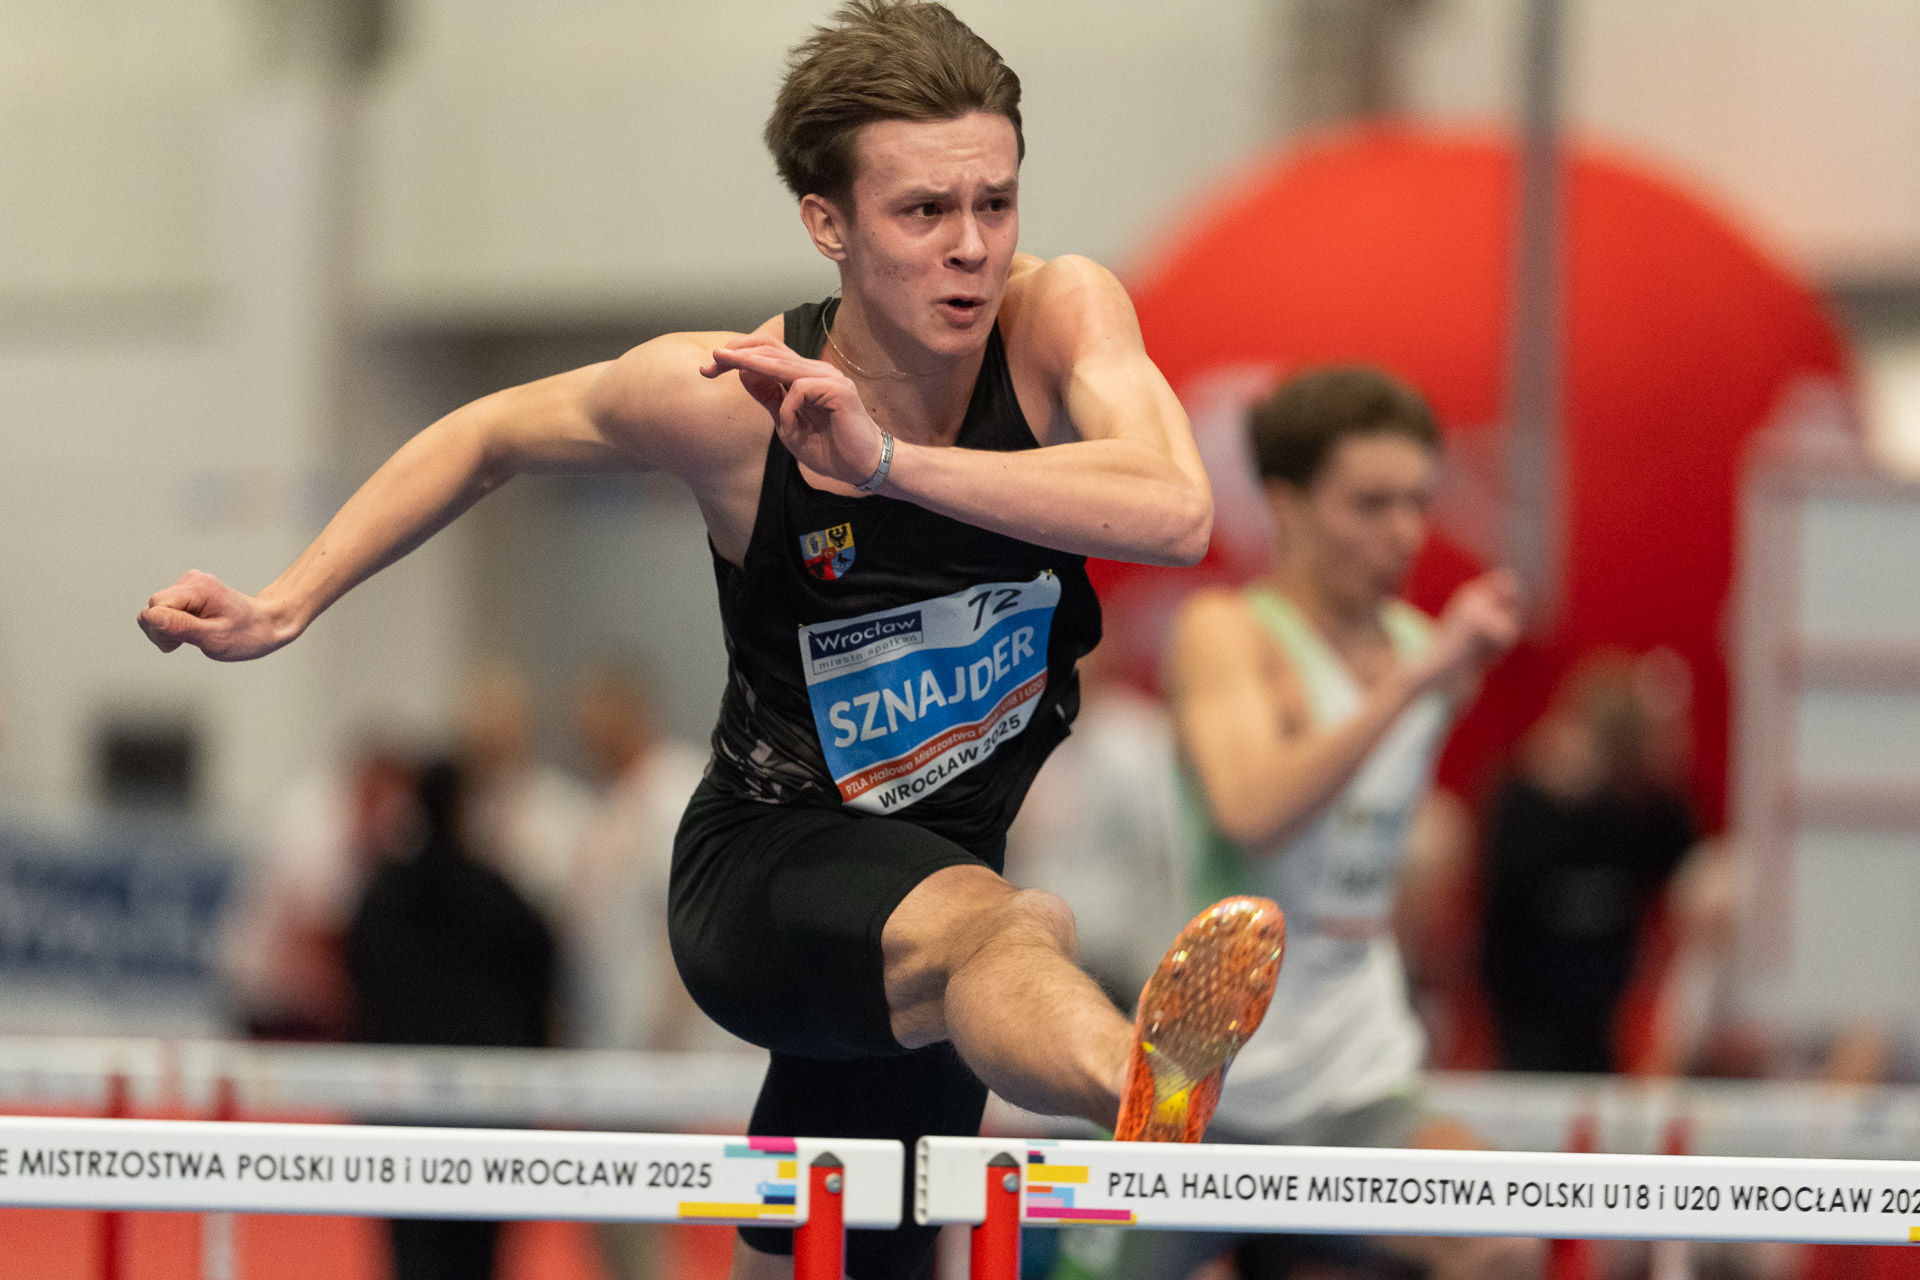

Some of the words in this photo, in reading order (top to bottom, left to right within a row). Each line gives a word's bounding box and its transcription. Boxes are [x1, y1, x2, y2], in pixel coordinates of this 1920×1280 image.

[815, 618, 916, 652] Wrocław
[819, 653, 863, 670] miasto
[829, 625, 1035, 748] SZNAJDER
[845, 777, 869, 795] PZLA
[868, 761, 914, 784] Halowe
[914, 729, 977, 766] Mistrzostwa
[878, 746, 979, 809] WROCŁAW
[982, 714, 1021, 754] 2025
[19, 1149, 225, 1178] MISTRZOSTWA
[238, 1154, 334, 1181] POLSKI
[345, 1157, 395, 1183] U18
[405, 1157, 411, 1182] i
[421, 1158, 472, 1185] U20
[483, 1159, 637, 1187] WROCŁAW
[647, 1162, 712, 1188] 2025
[1108, 1172, 1169, 1198] PZLA
[1181, 1173, 1298, 1201] HALOWE
[1307, 1176, 1495, 1205] MISTRZOSTWA
[1506, 1181, 1593, 1208] POLSKI
[1603, 1183, 1650, 1209] U18
[1658, 1184, 1665, 1209] i
[1674, 1185, 1720, 1211] U20
[1730, 1186, 1872, 1213] WROCŁAW
[1880, 1187, 1920, 1214] 202
